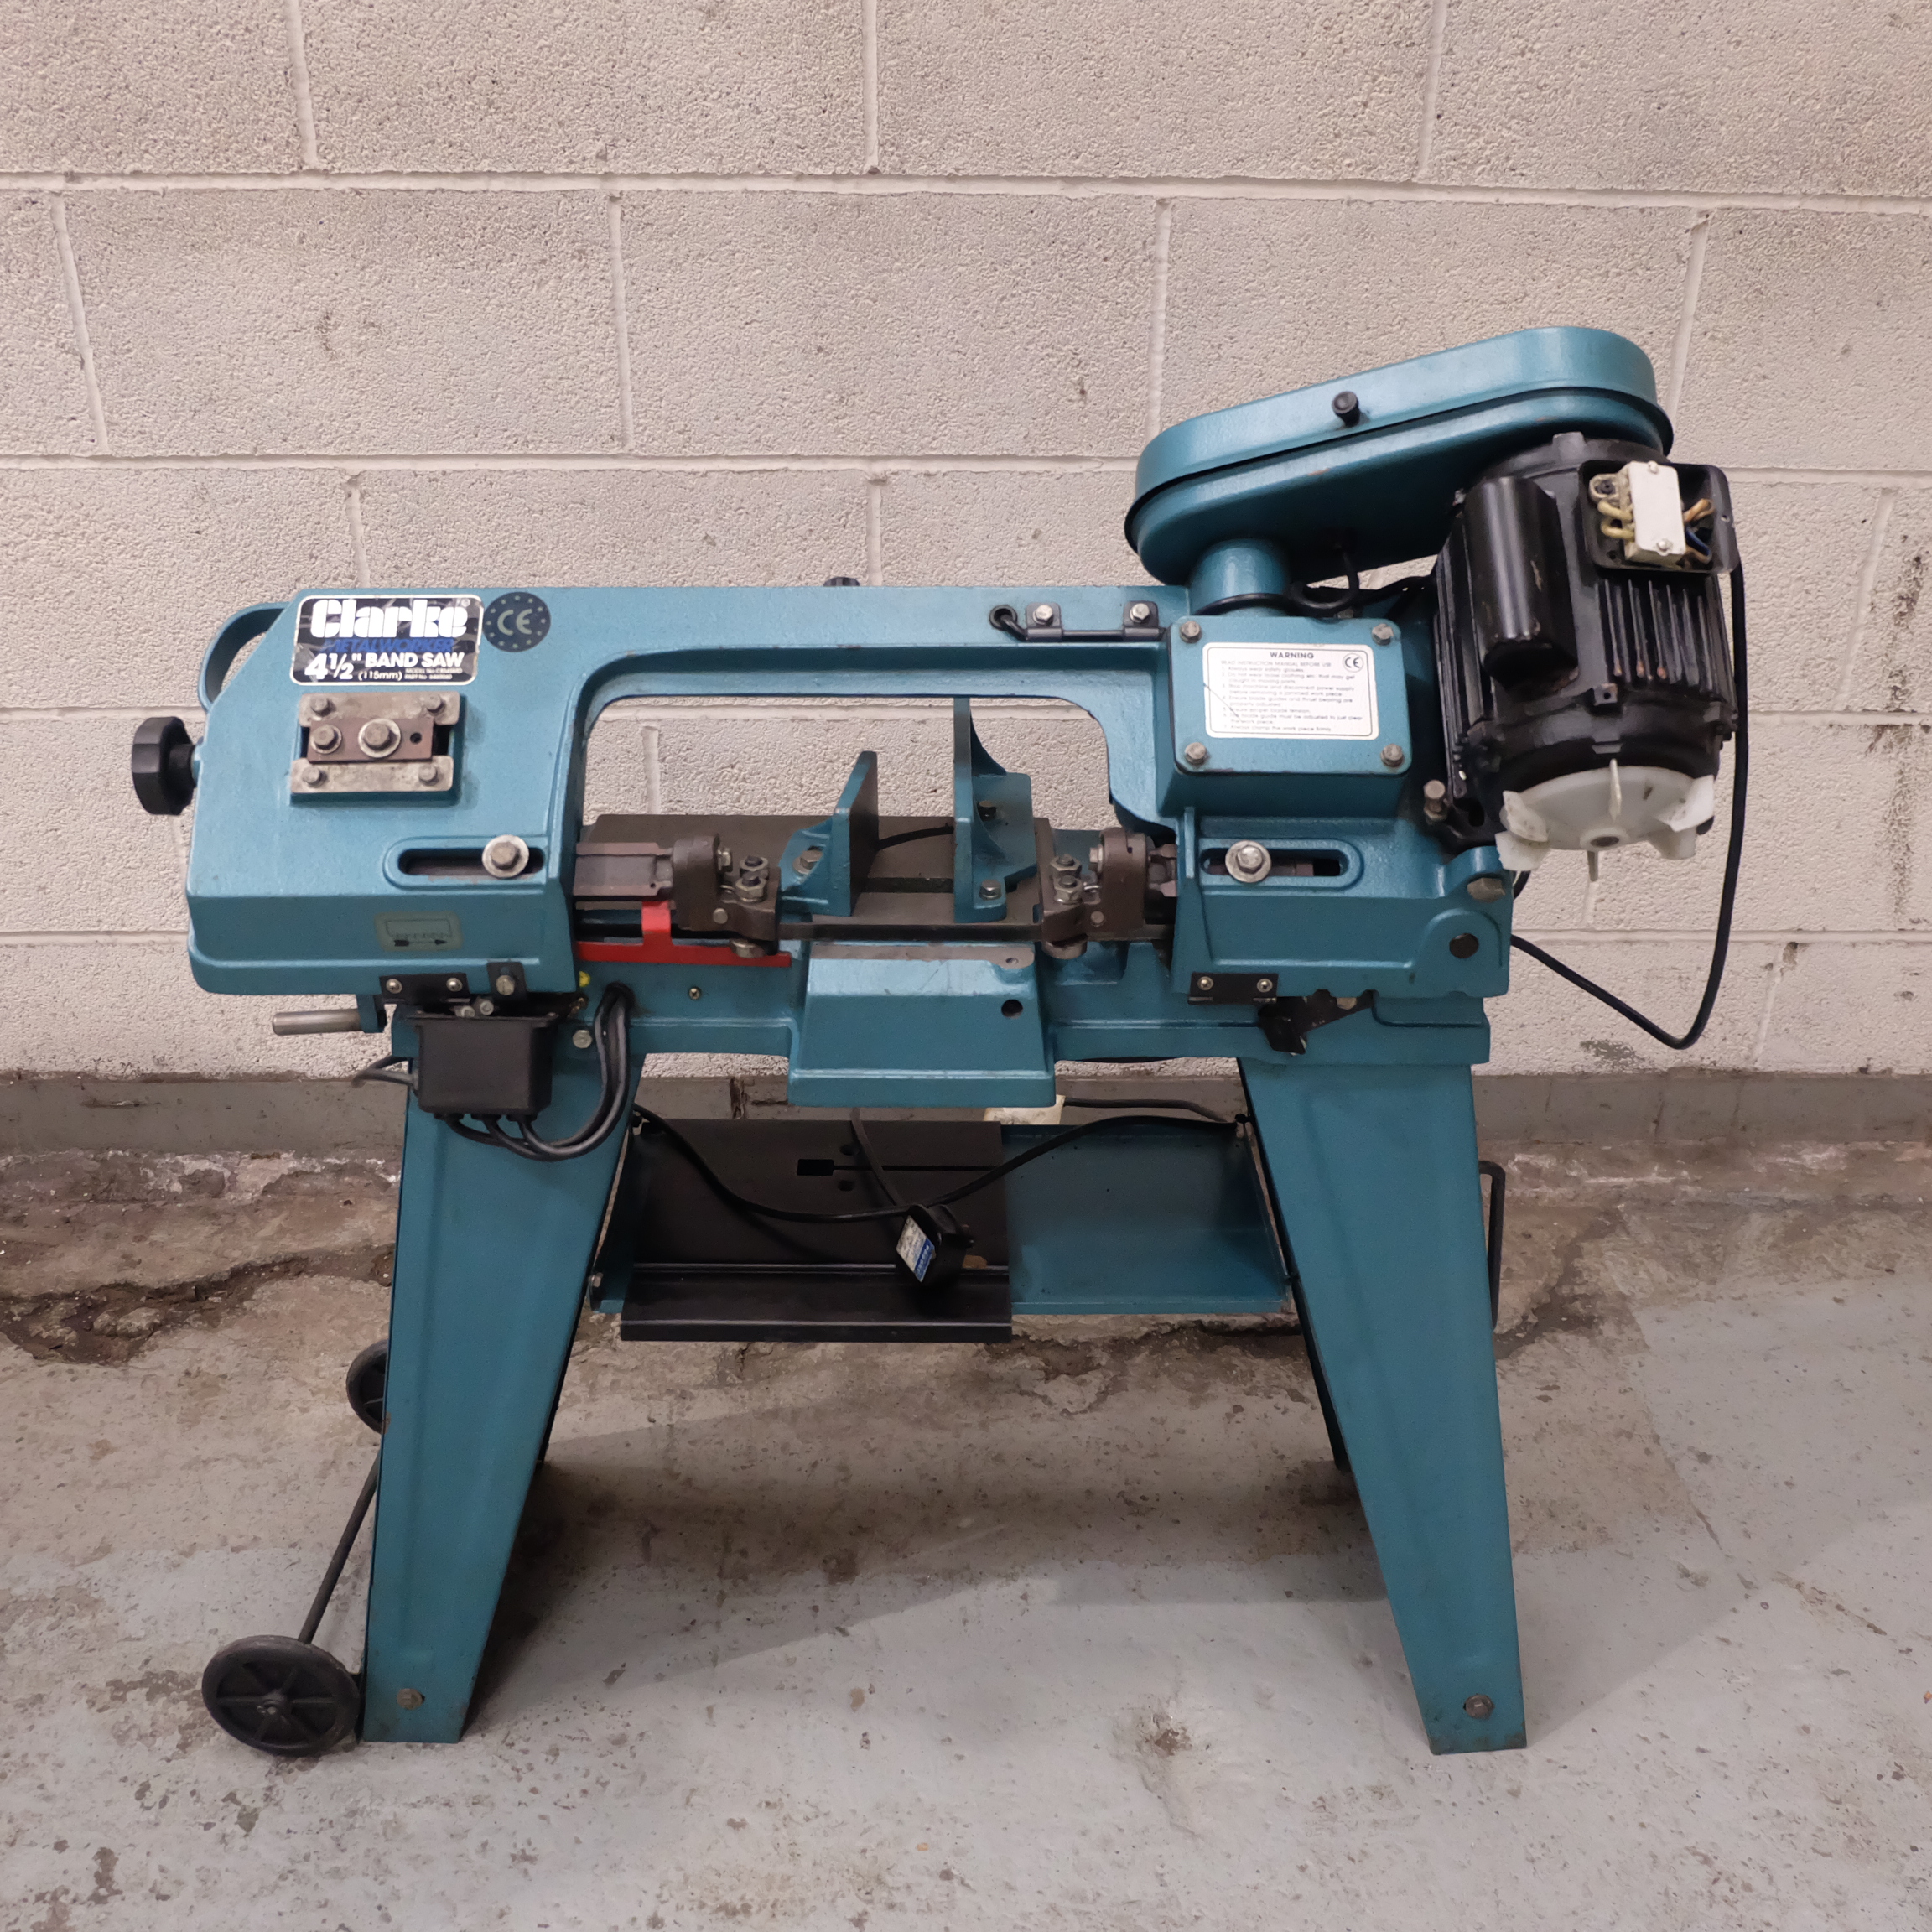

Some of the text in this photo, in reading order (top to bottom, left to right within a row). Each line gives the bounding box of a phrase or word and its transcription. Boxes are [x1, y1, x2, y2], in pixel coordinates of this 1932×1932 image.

[310, 599, 468, 638] Clarke
[497, 609, 532, 636] CE
[365, 653, 418, 667] BAND
[422, 652, 464, 667] SAW
[1345, 657, 1360, 668] CE
